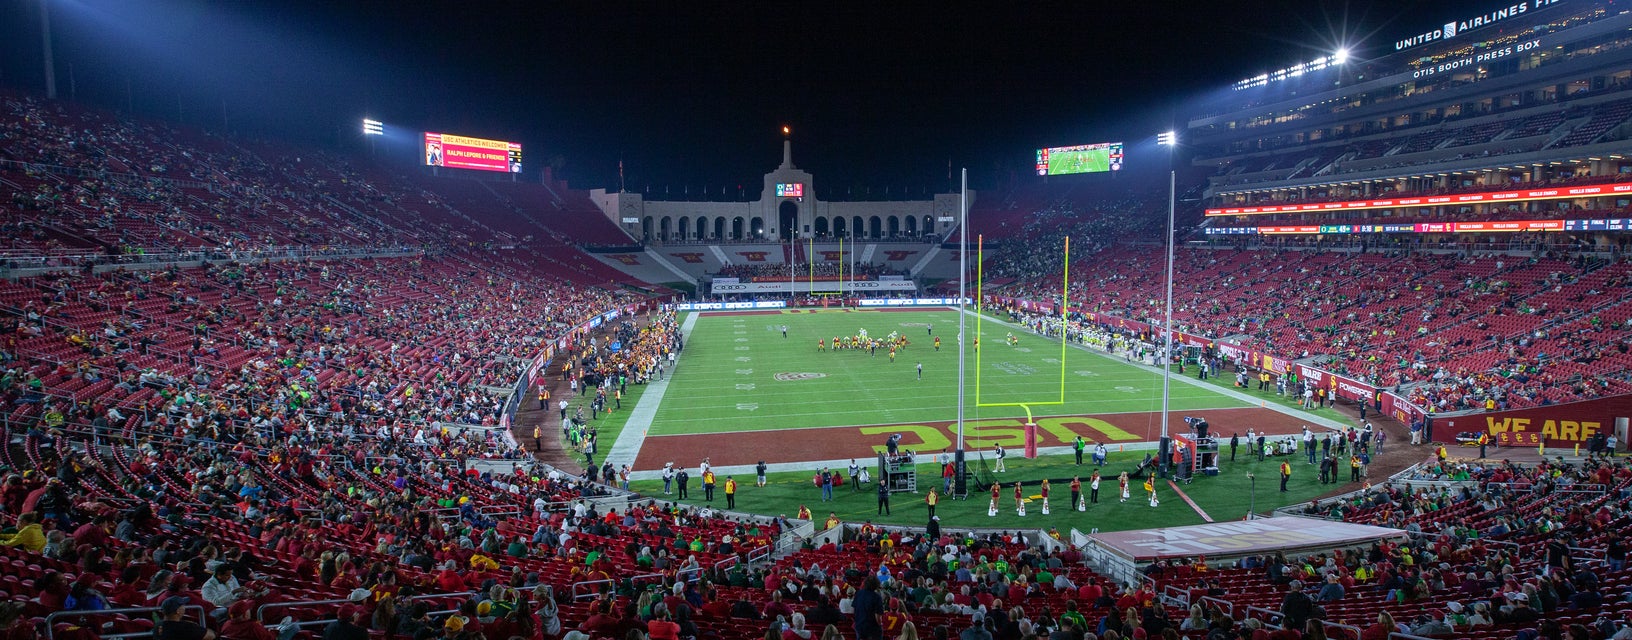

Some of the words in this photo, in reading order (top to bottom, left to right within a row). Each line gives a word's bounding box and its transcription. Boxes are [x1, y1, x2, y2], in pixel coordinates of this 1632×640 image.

[1396, 30, 1441, 50] UNITED
[1458, 2, 1528, 32] AIRLINES
[1414, 67, 1434, 78] OTIS
[1438, 58, 1472, 72] BOOTH
[1477, 48, 1512, 62] PRESS
[1517, 39, 1540, 51] BOX
[455, 137, 480, 146] ATHLETICS
[858, 416, 1144, 456] USC
[1486, 416, 1531, 436] WE
[1542, 420, 1601, 441] ARE
[888, 616, 897, 630] 7
